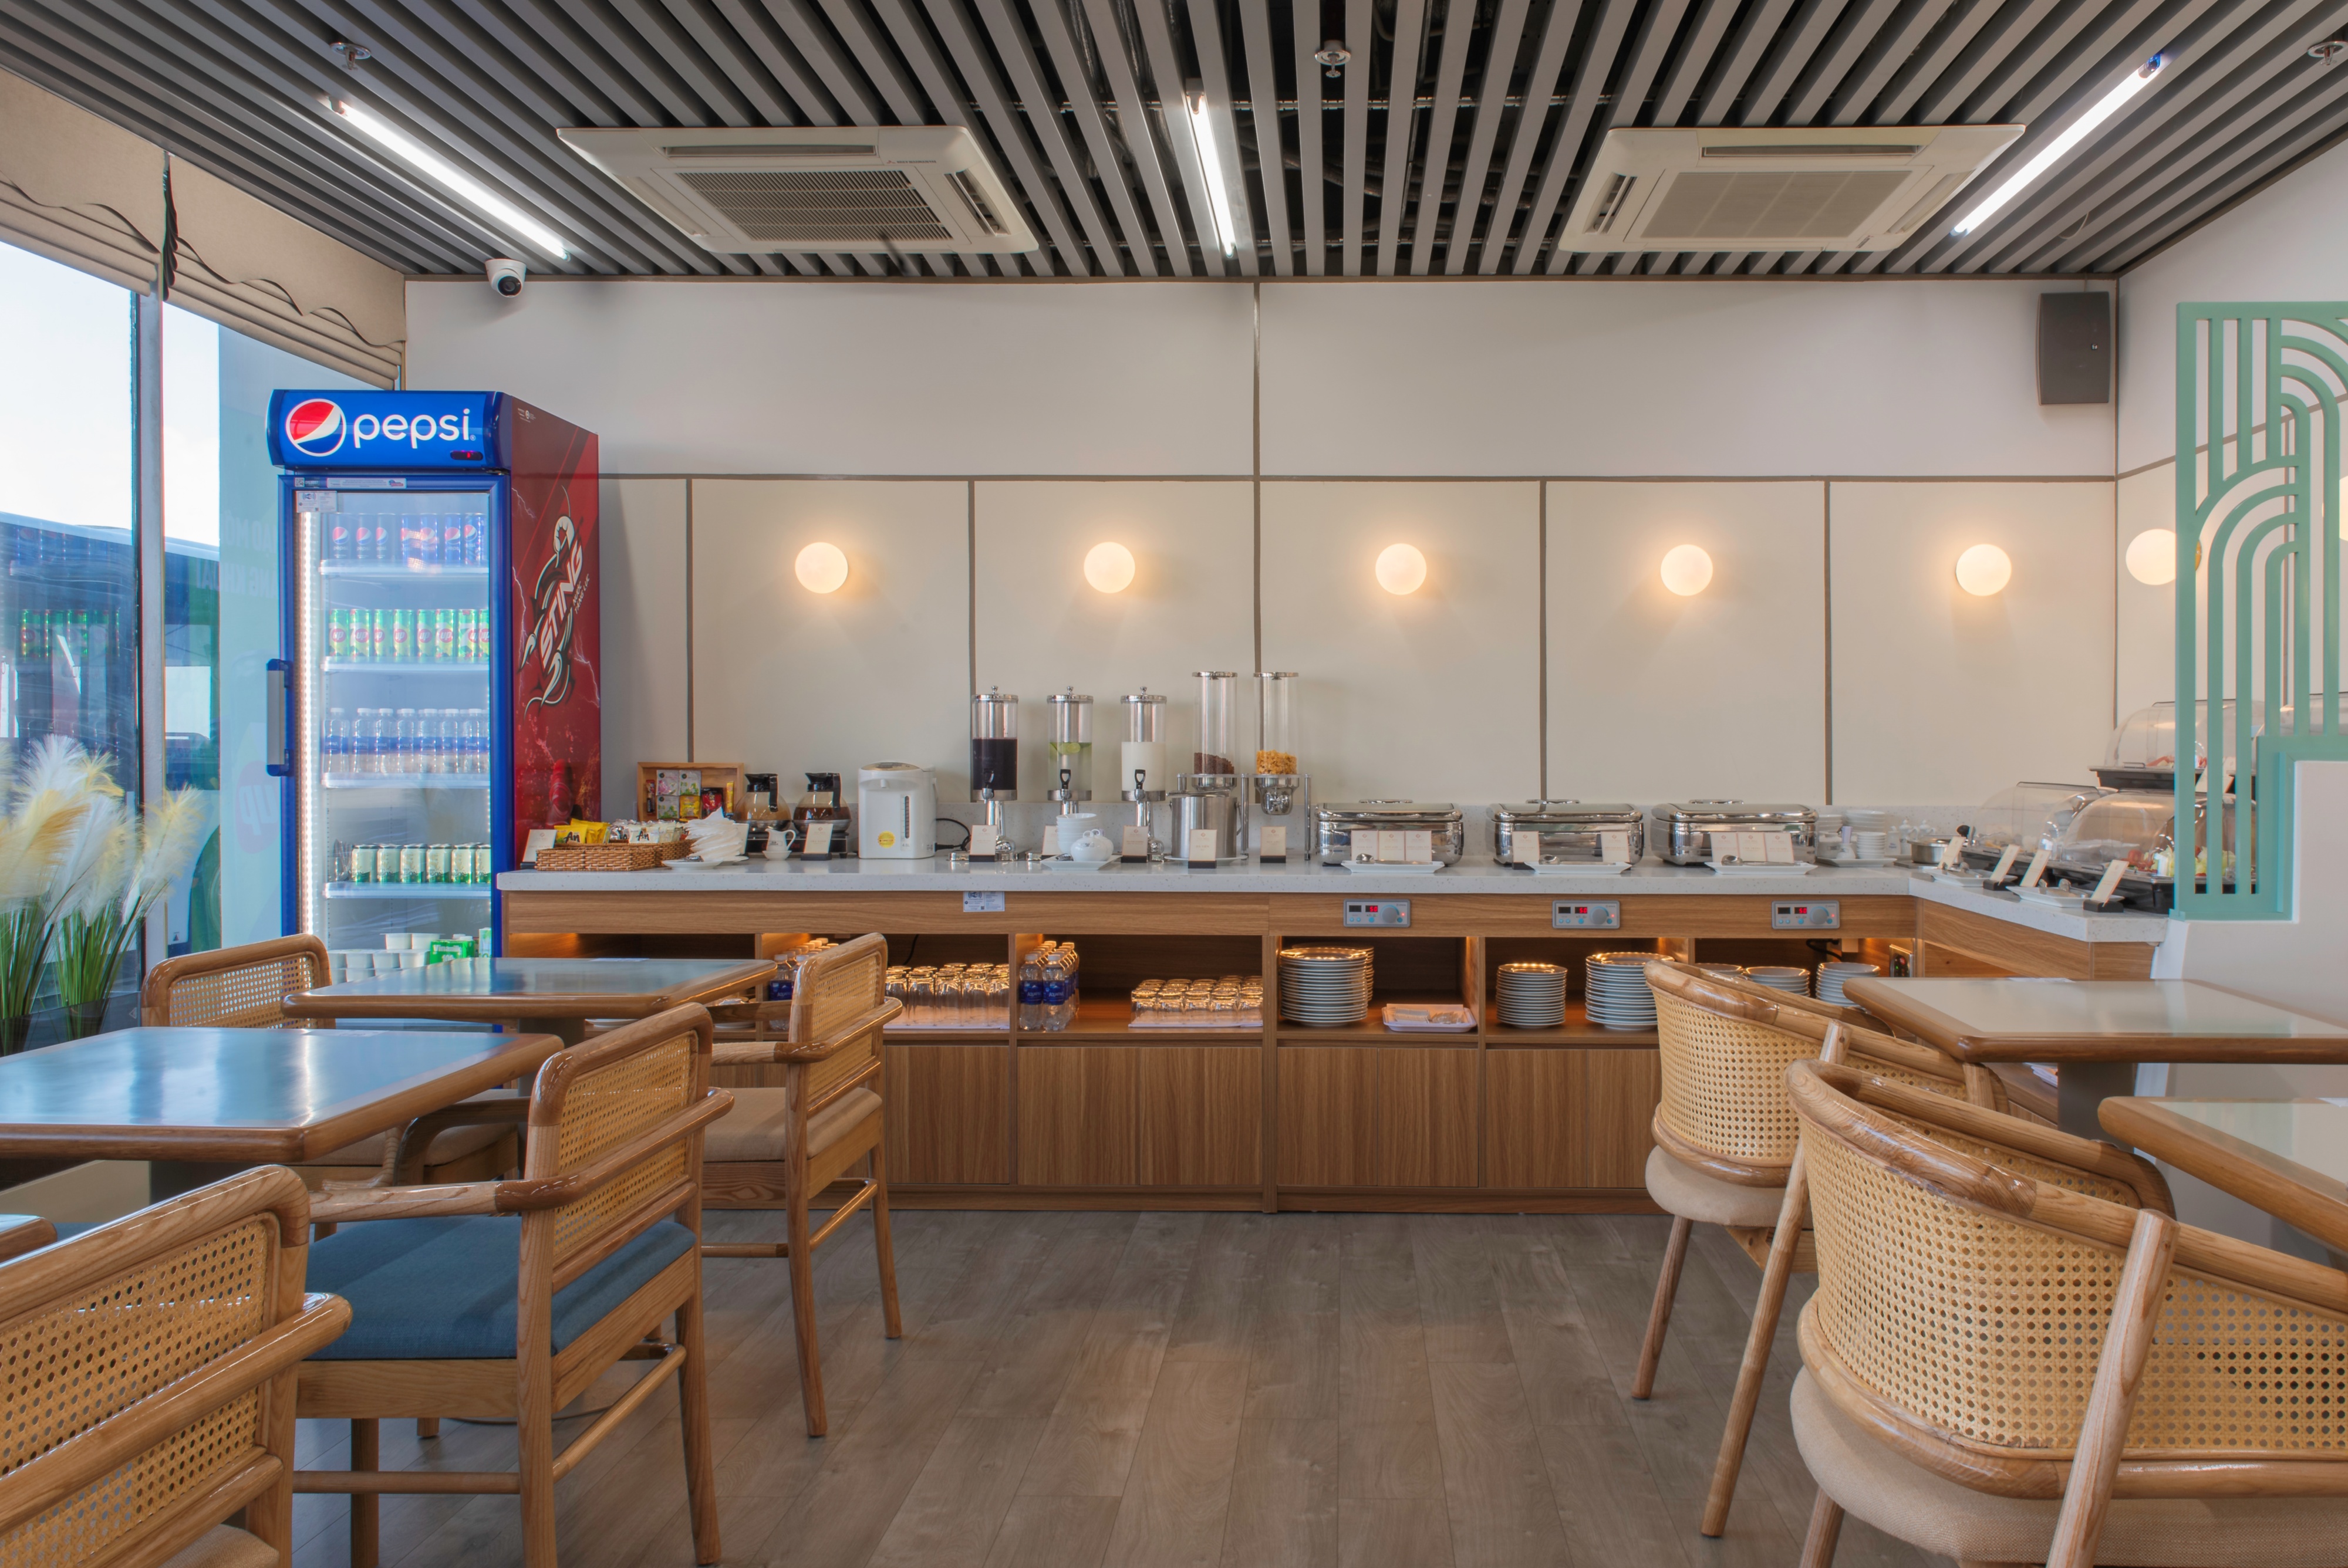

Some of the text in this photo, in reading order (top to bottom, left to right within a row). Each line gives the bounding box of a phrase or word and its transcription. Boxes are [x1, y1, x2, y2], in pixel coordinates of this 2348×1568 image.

[353, 408, 470, 449] pepsi
[541, 539, 583, 670] STING
[564, 831, 581, 843] An
[636, 830, 649, 841] An
